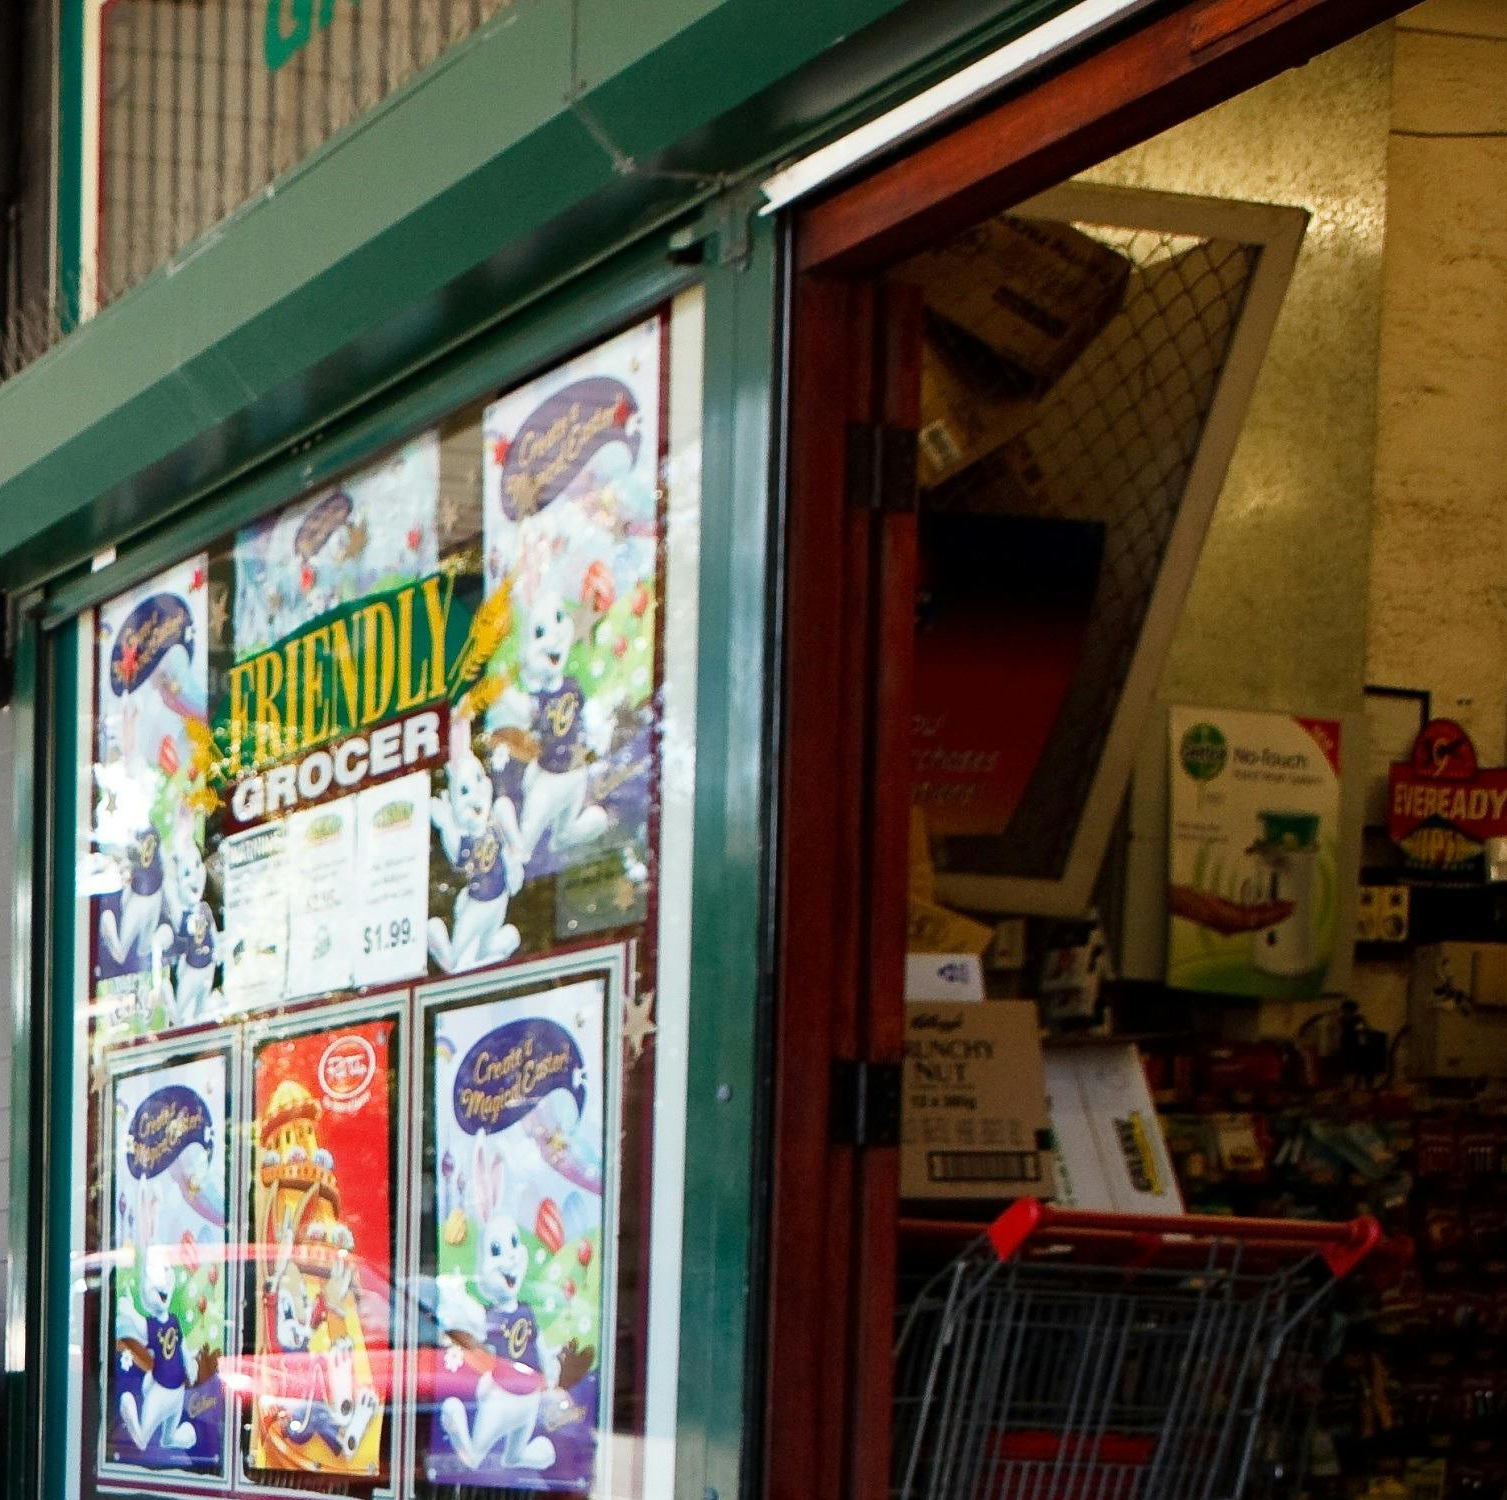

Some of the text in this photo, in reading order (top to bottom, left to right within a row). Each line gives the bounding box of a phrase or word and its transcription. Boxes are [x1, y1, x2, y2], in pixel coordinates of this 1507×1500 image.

[229, 567, 455, 775] FRIENDLY
[232, 711, 441, 823] GROCER
[1393, 783, 1507, 820] EVEREADY
